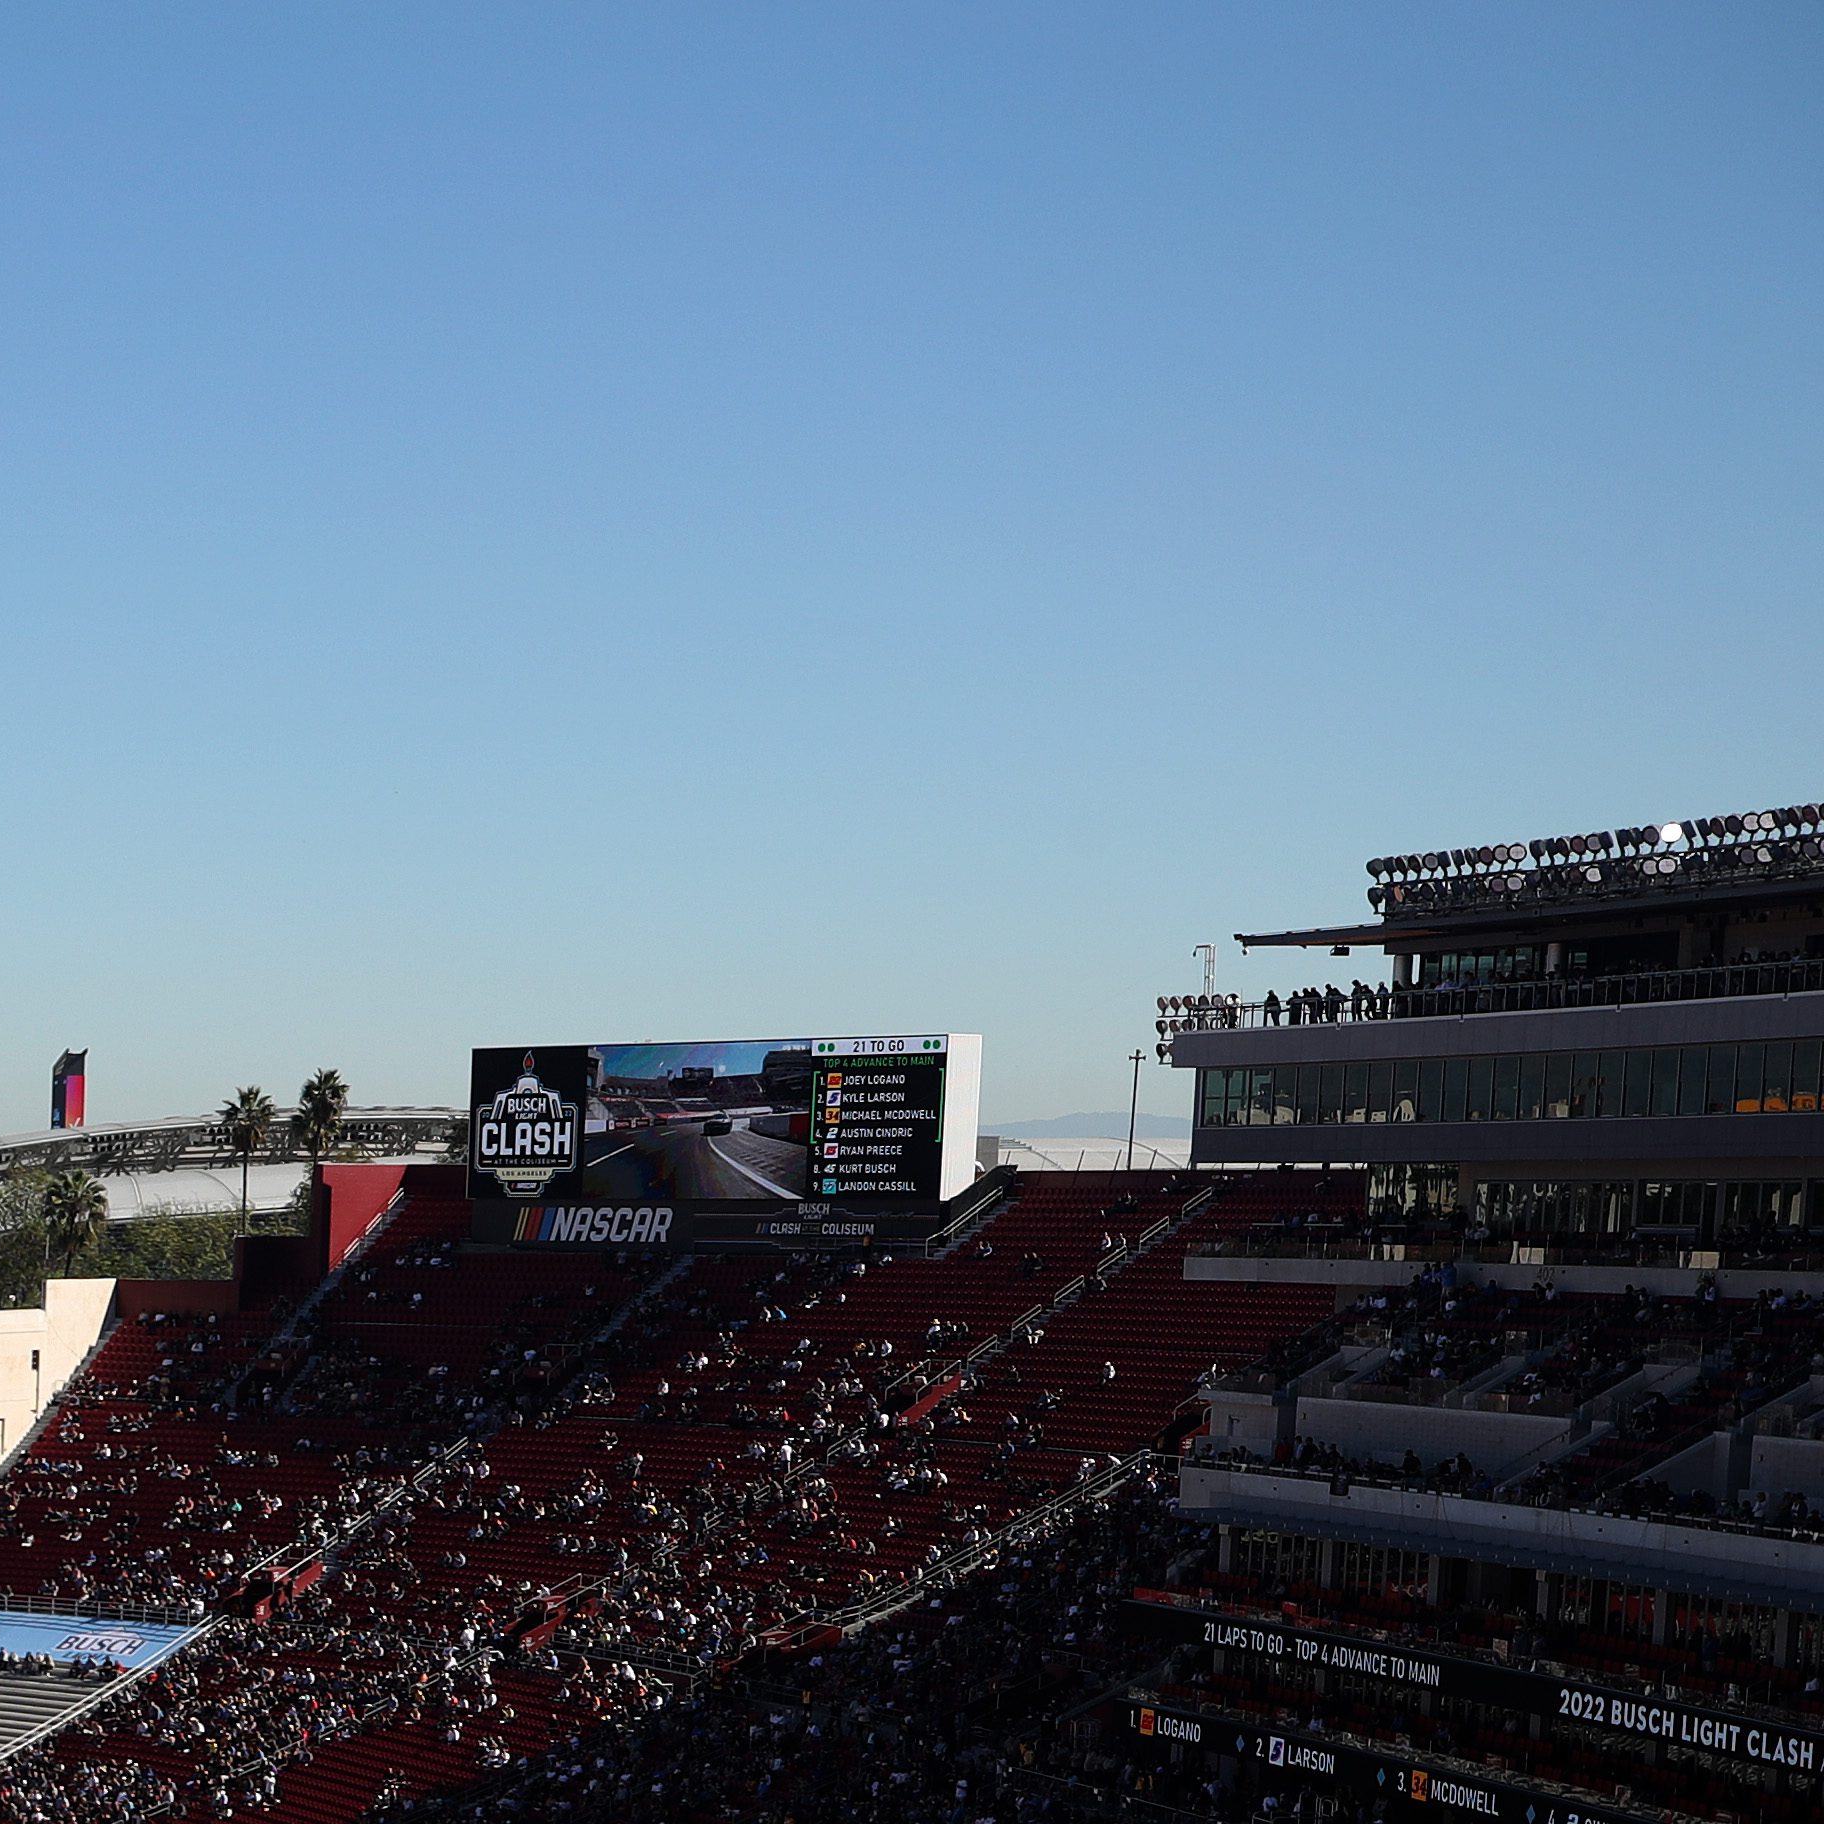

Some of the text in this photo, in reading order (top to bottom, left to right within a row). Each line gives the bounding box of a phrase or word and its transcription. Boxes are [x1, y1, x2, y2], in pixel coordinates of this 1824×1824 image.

[853, 1040, 904, 1052] 21 TO GO
[824, 1056, 934, 1068] TOP ADVANCE TO MAIN
[844, 1075, 905, 1085] JOEY LOGANO
[842, 1093, 904, 1103] KYLE LARSON
[508, 1098, 546, 1113] BUSCH
[842, 1110, 936, 1120] MICHAEL MCDOWELL
[482, 1122, 571, 1155] CLASH
[840, 1128, 913, 1138] AUSTIN CINDRIC
[840, 1146, 902, 1155] RYAN PREECE
[839, 1164, 896, 1173] KURT BUSCH
[838, 1182, 916, 1191] LANDON CASSILL
[798, 1203, 831, 1215] BUSCH
[551, 1207, 673, 1242] NASCAR
[769, 1223, 874, 1236] CLASH COLISEUM
[56, 1635, 147, 1656] BUSCH
[1205, 1622, 1440, 1687] 21 LAPS TO GO TOP 4 ADVANCE TO MAIN
[1559, 1689, 1814, 1769] 2022 BUSCH LIGHT CLASH
[1157, 1716, 1201, 1743] LOGANO
[1287, 1745, 1335, 1775] LARSON
[1431, 1780, 1499, 1817] MCDOWELL
